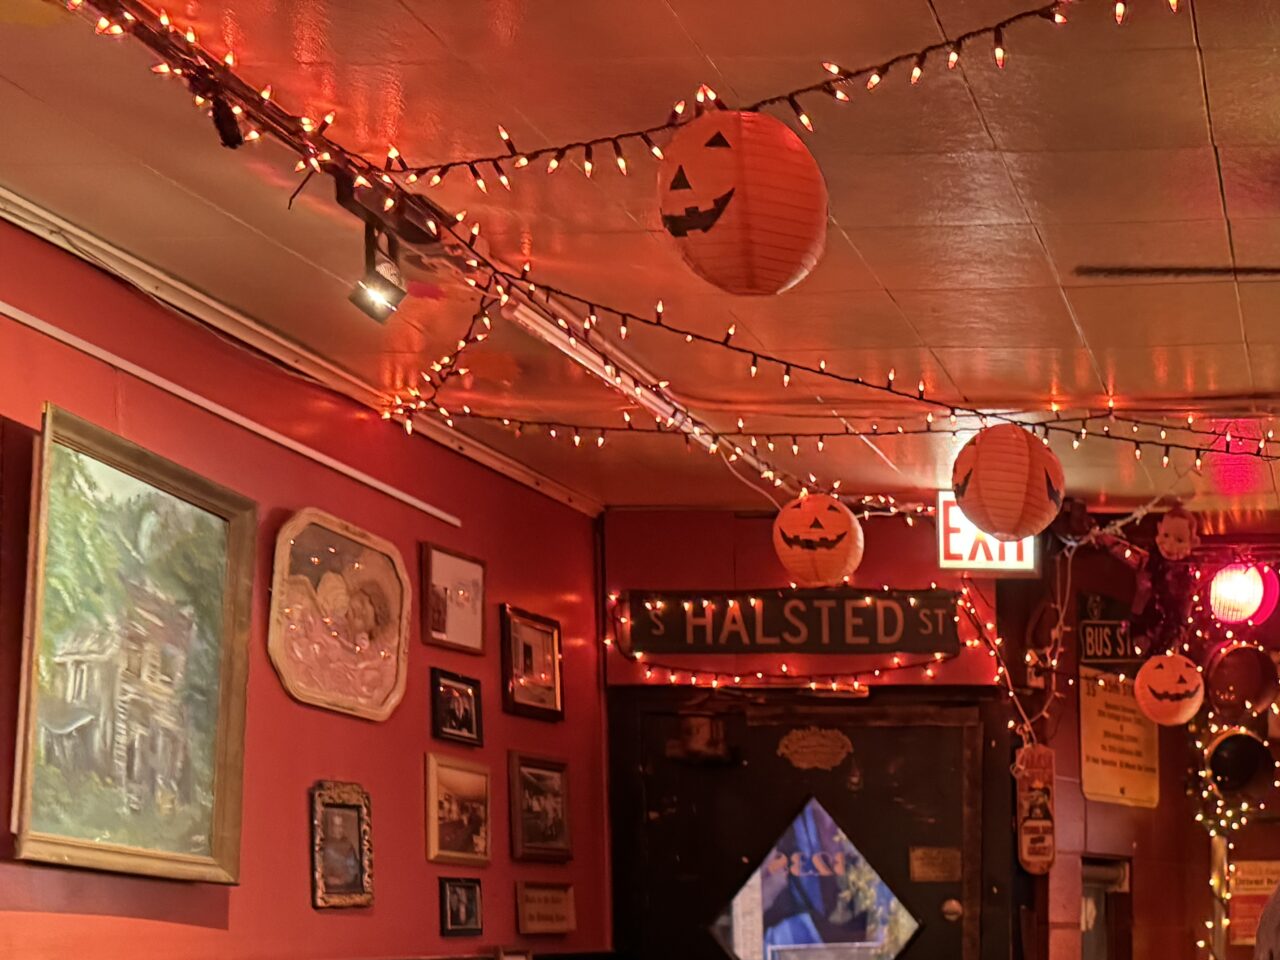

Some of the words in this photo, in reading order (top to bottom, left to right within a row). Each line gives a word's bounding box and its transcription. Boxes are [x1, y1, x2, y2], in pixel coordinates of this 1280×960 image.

[649, 608, 665, 635] S
[685, 599, 905, 645] HALSTED
[918, 608, 947, 635] ST
[1085, 626, 1112, 656] BUS
